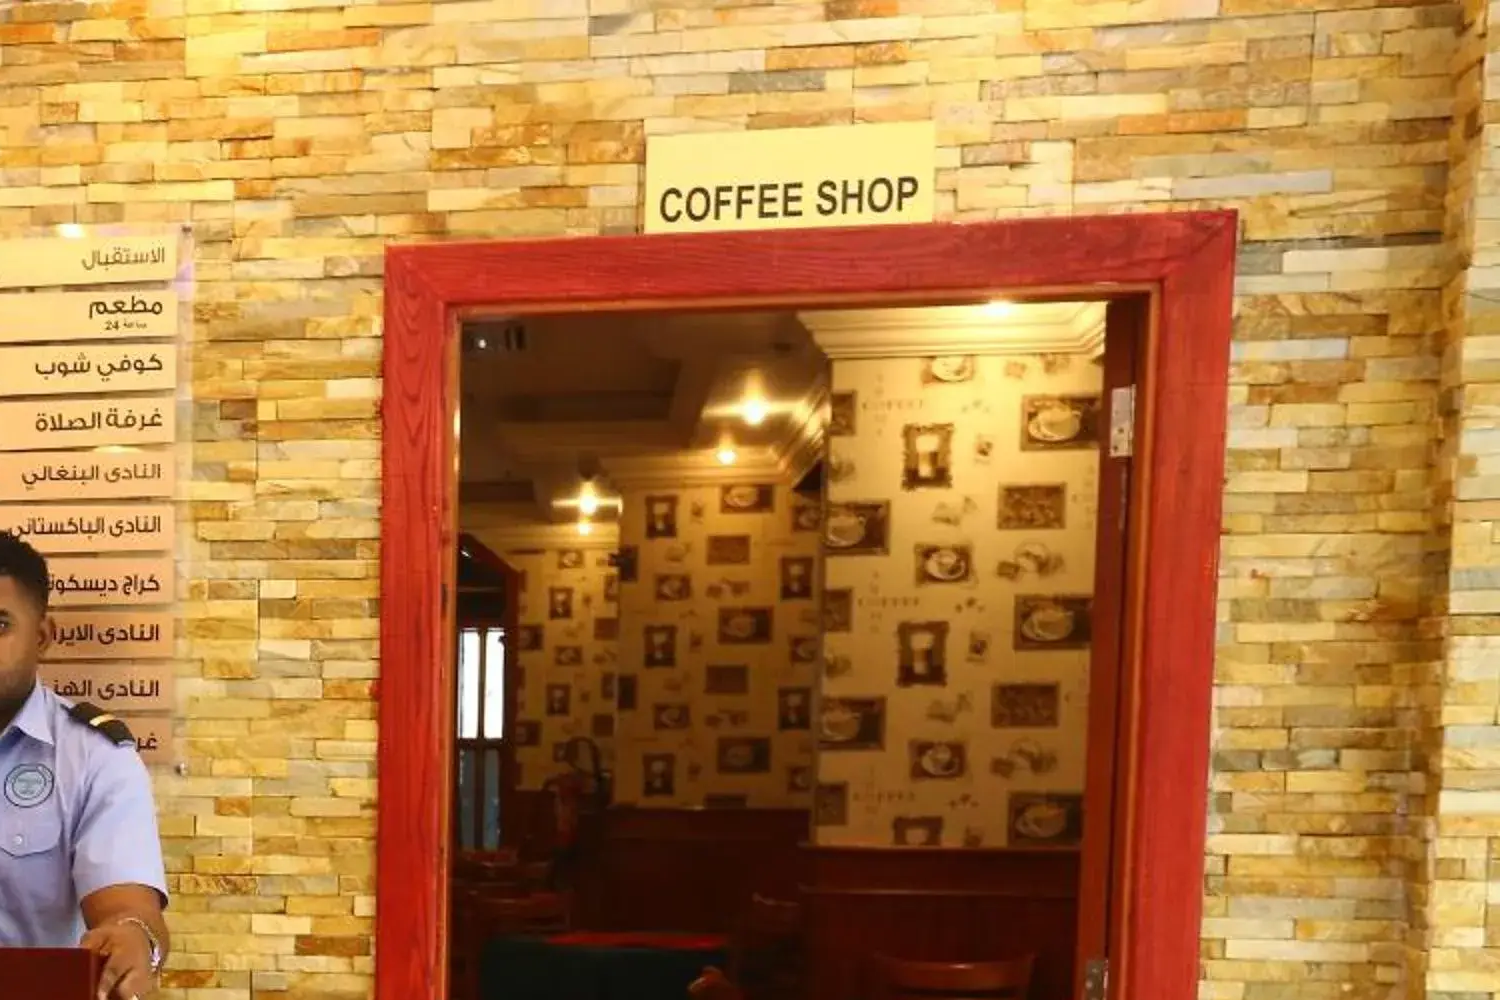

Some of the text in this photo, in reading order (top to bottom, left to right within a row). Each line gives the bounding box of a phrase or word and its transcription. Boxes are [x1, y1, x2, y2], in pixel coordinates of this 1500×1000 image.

[659, 176, 919, 223] COFFEE SHOP
[82, 247, 165, 271] الاستقبال
[89, 295, 163, 320] مطعم
[105, 320, 119, 330] 24
[35, 353, 163, 382] كوفي شوب
[36, 407, 163, 433] غرفة الصلاة
[21, 465, 99, 490] البنغالي
[122, 575, 161, 596] كراج
